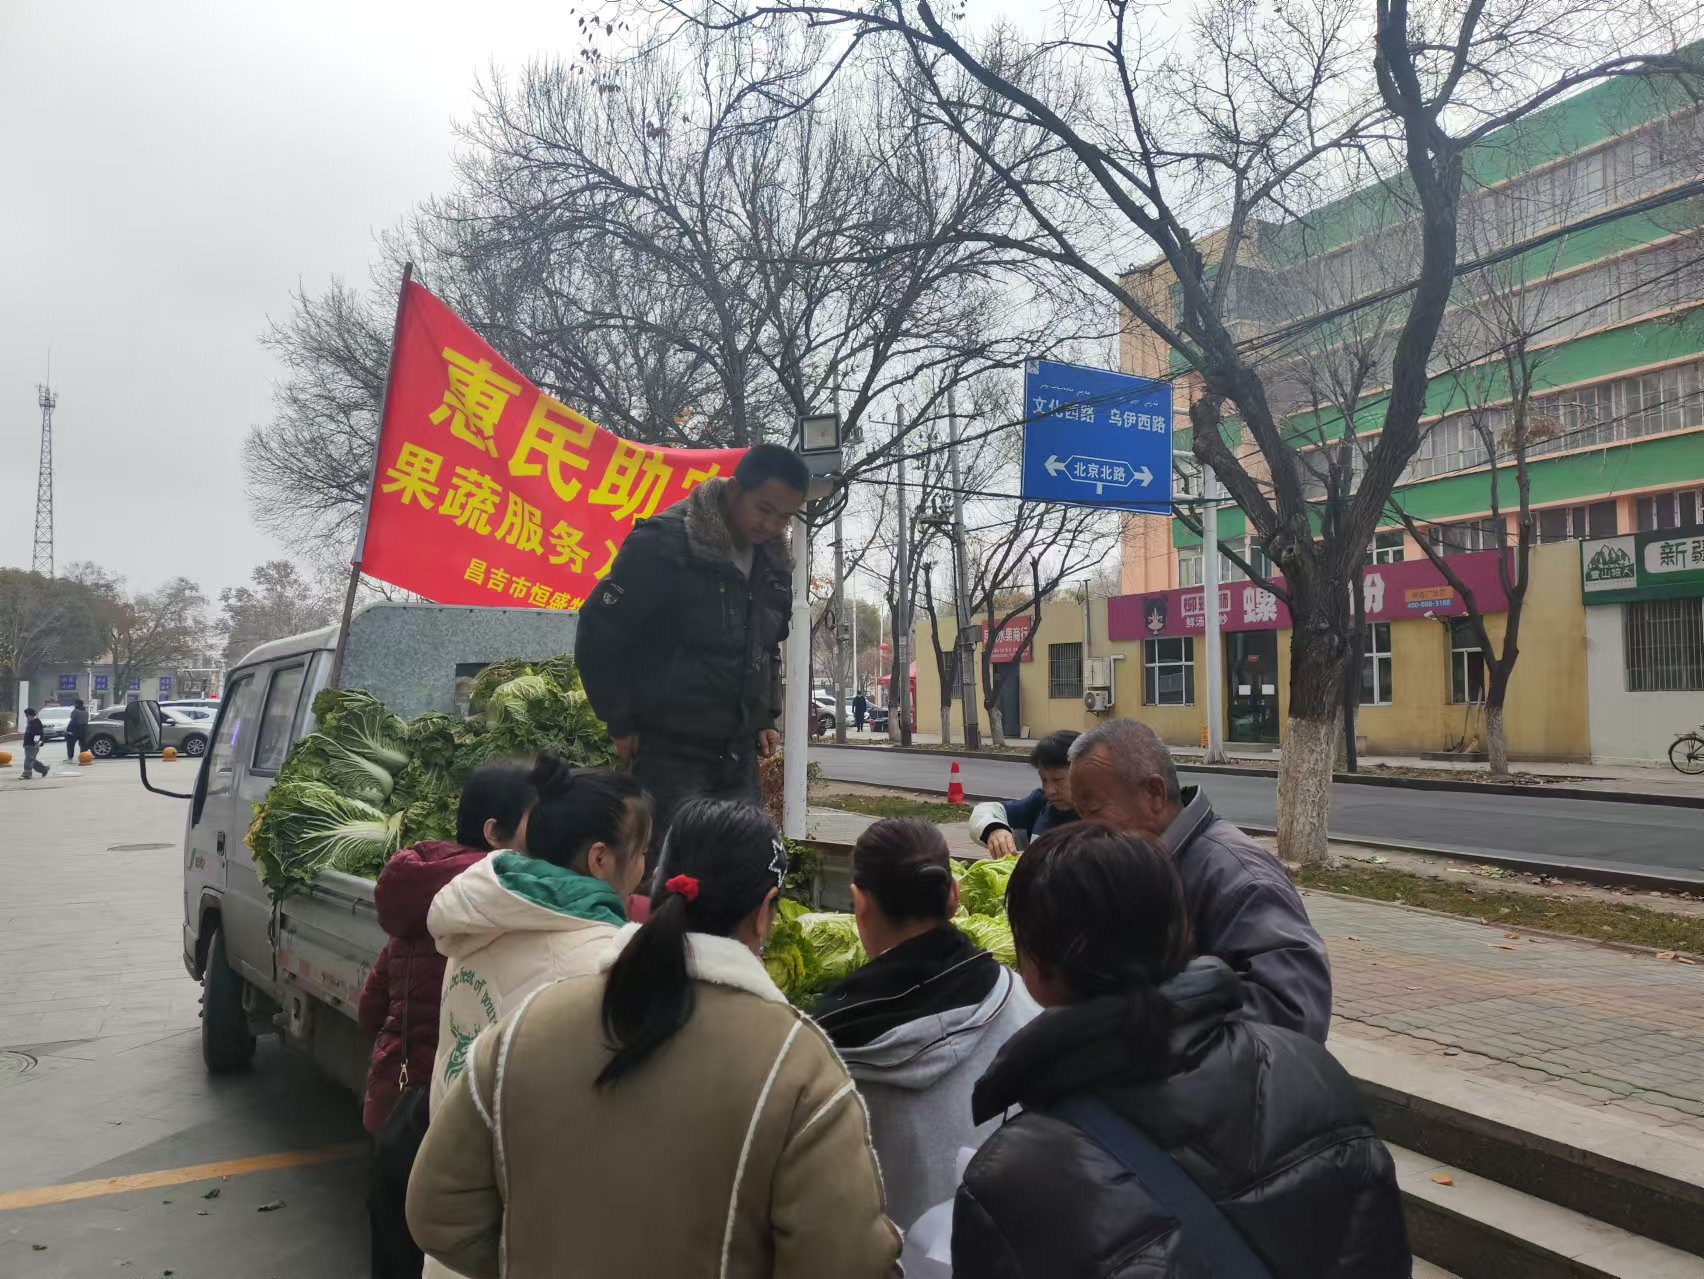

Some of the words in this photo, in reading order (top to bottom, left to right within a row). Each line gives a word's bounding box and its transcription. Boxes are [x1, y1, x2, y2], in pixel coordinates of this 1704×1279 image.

[1033, 396, 1094, 423] 文化西路
[1108, 408, 1166, 433] 乌伊西路
[428, 346, 722, 526] 惠民助
[1073, 461, 1126, 482] 北京北路
[382, 442, 619, 580] 果蔬服务
